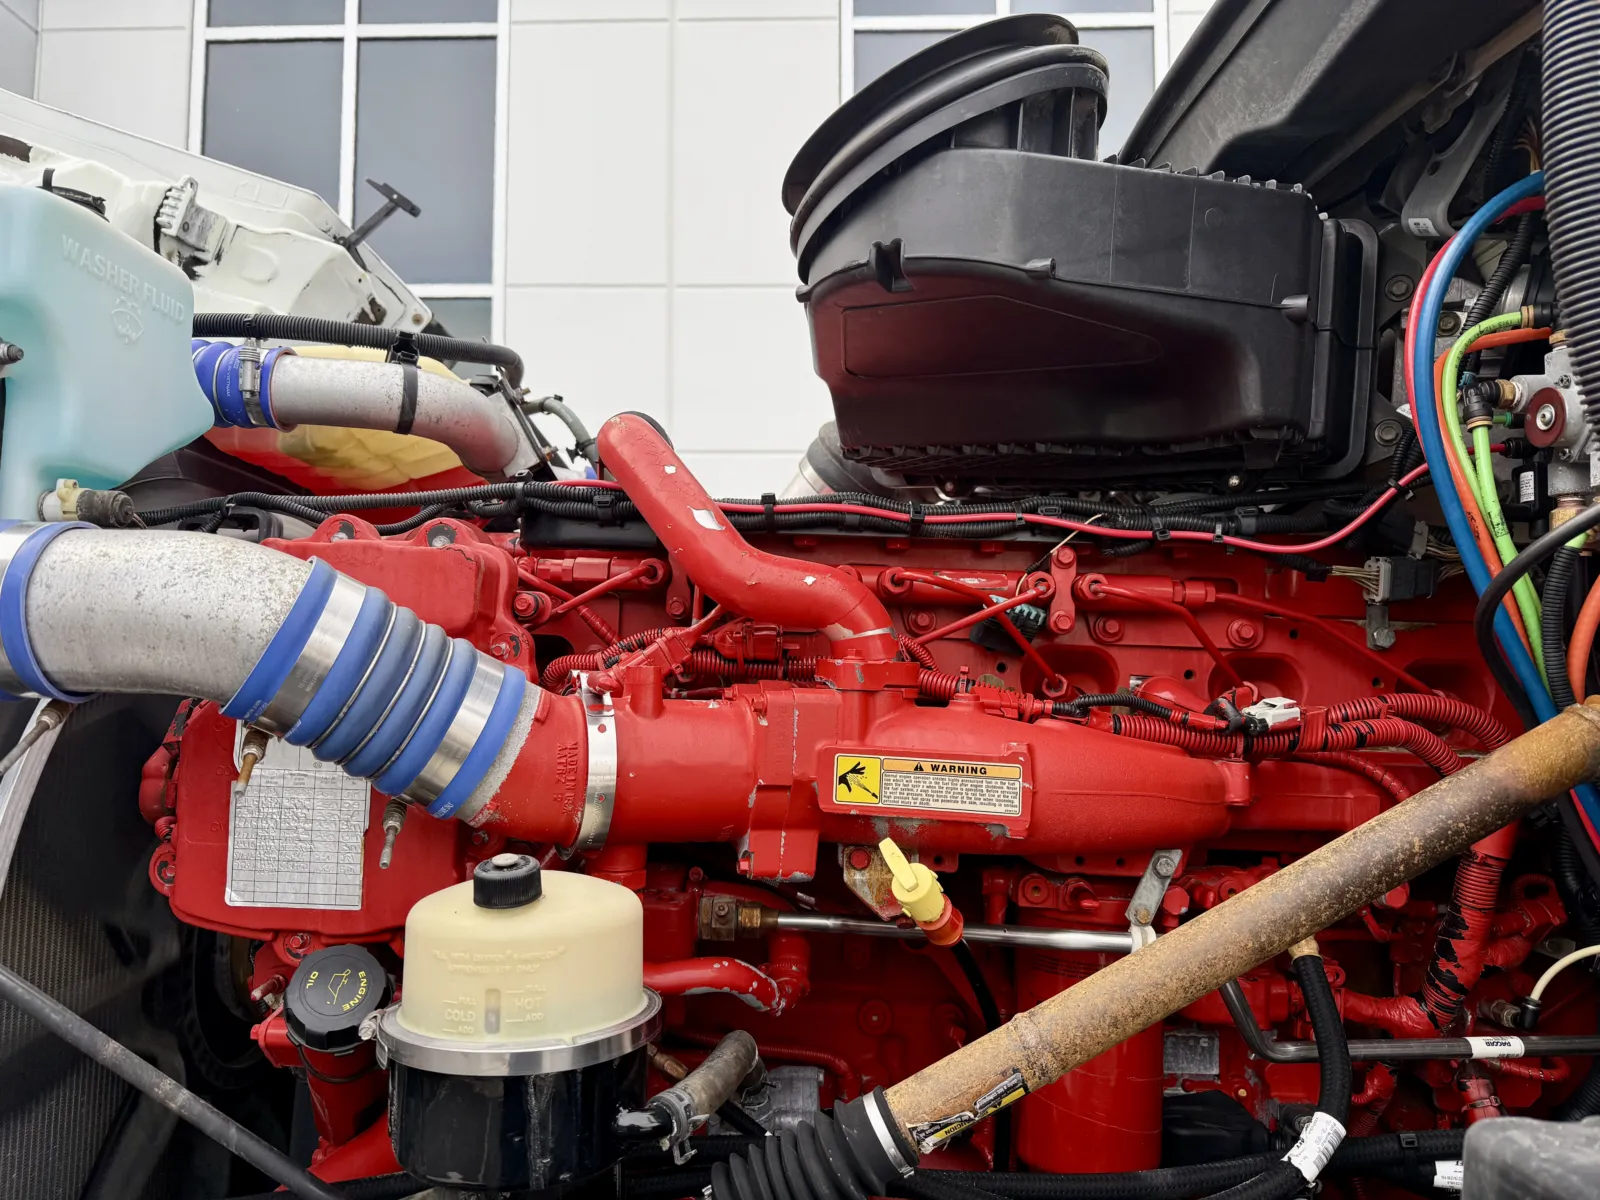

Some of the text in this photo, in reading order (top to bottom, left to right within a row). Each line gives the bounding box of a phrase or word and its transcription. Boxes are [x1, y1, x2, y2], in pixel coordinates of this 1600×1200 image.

[61, 234, 186, 322] WASHER FLUID
[567, 741, 579, 774] MADE
[931, 764, 987, 775] WARNING
[566, 777, 576, 790] IN
[517, 964, 540, 974] ONLY
[306, 971, 367, 1011] OIL ENGINE
[458, 996, 477, 1006] FULL
[514, 996, 543, 1009] HOT
[445, 1009, 476, 1022] COLD
[525, 1012, 544, 1022] ADD
[457, 1025, 474, 1034] ADD
